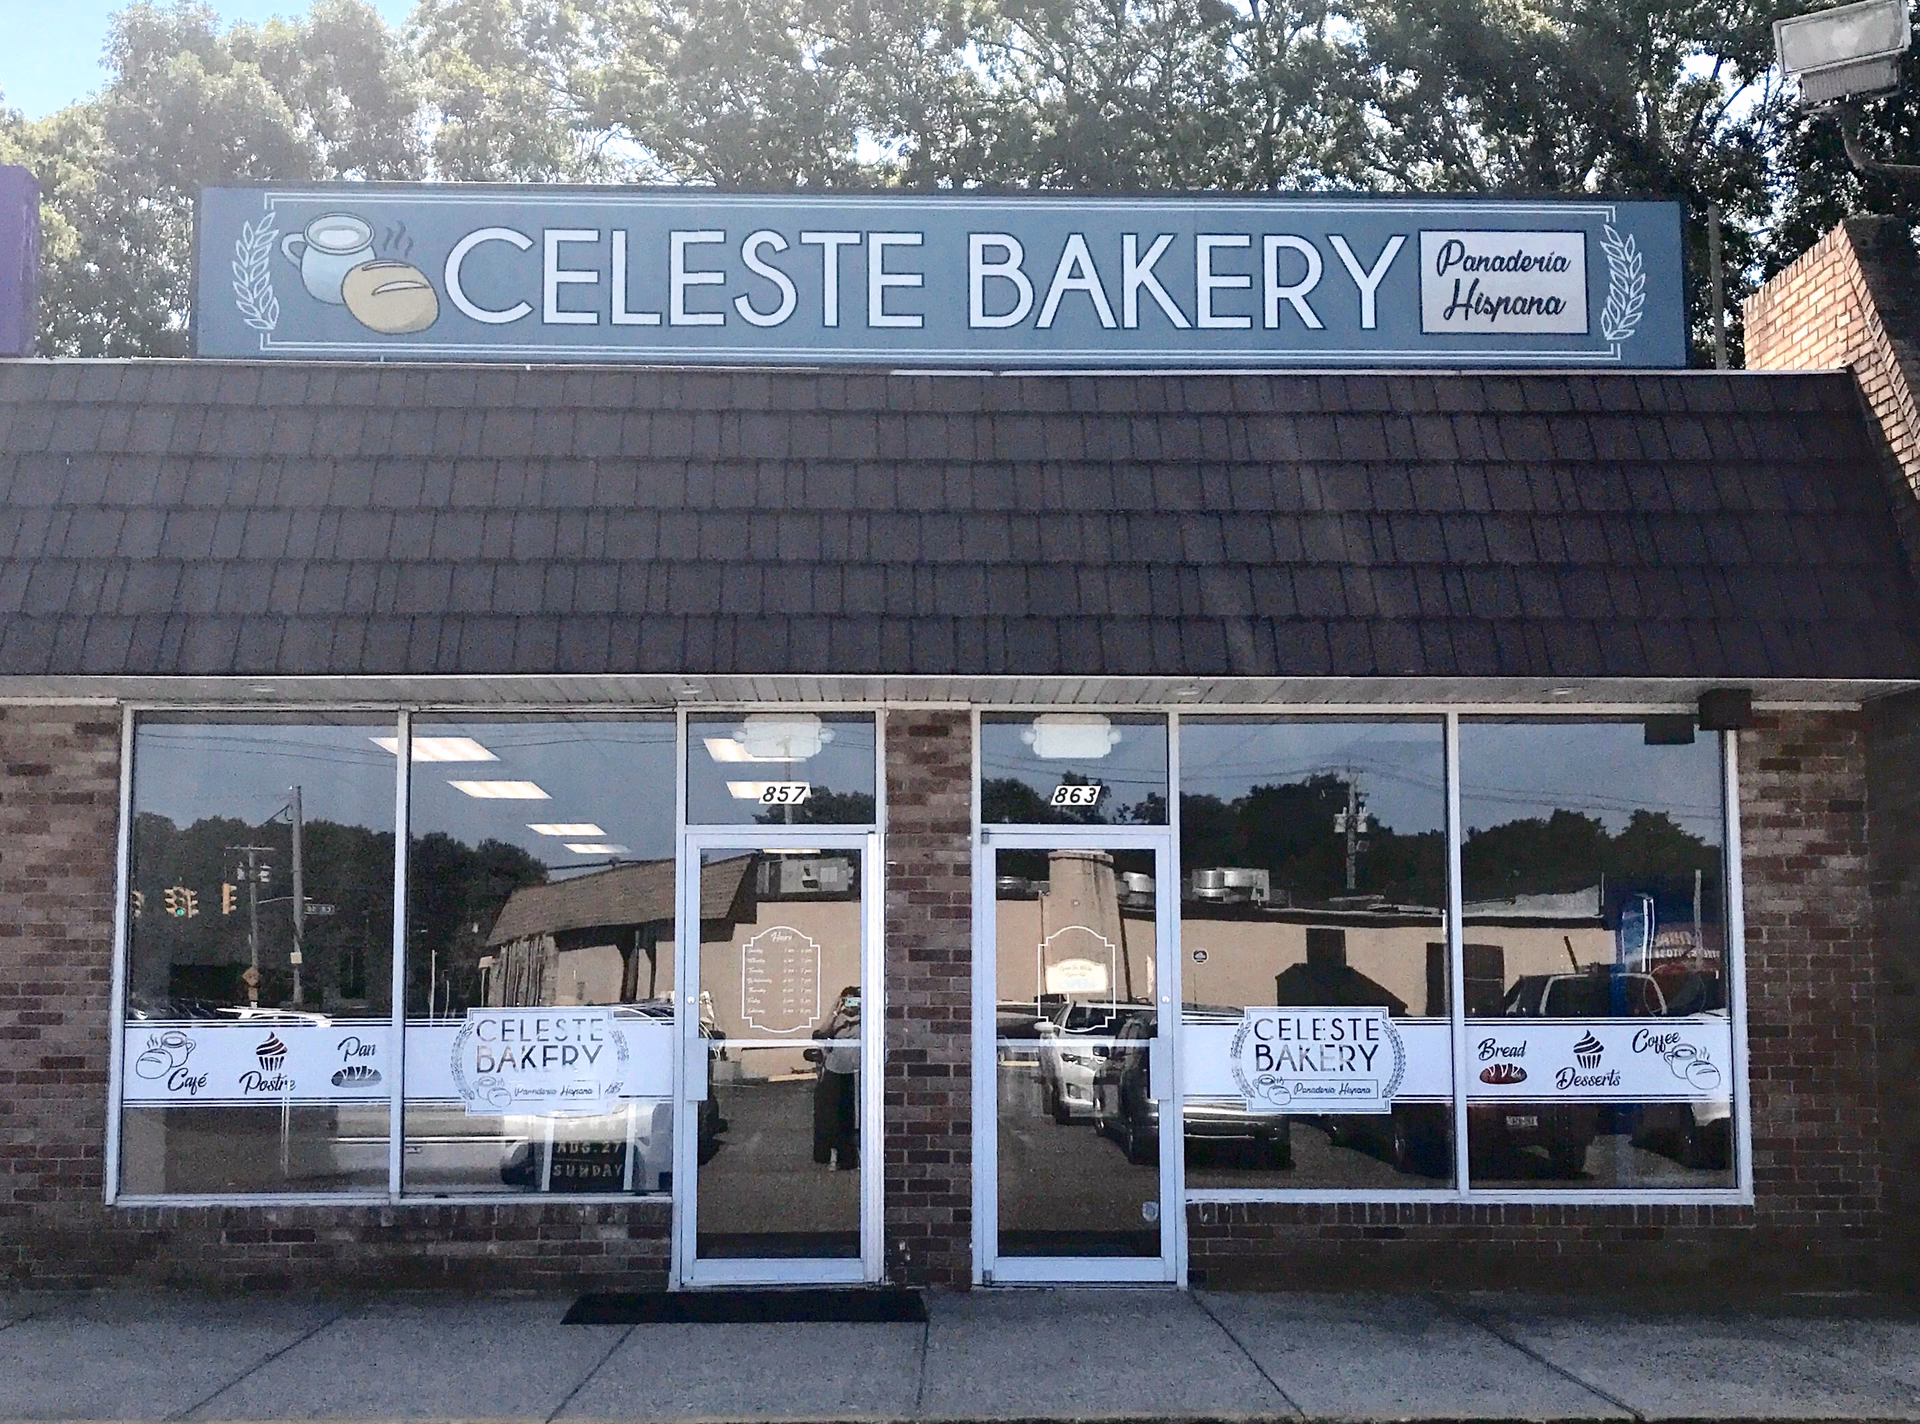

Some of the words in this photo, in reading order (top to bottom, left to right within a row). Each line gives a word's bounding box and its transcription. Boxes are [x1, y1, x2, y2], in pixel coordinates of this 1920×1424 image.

[1437, 239, 1571, 276] Panadería
[445, 227, 925, 329] CELESTE
[966, 232, 1408, 330] BAKERY
[1443, 278, 1567, 322] Hispana
[763, 786, 807, 803] 857
[1054, 787, 1098, 803] 863
[476, 1018, 604, 1042] CELESTE
[1254, 1018, 1379, 1041] CELESTE
[1632, 1028, 1681, 1054] Coffee
[337, 1036, 376, 1062] Pan
[476, 1044, 604, 1073] BAKERY
[1255, 1044, 1379, 1072] BAKERY
[1477, 1037, 1527, 1061] Bread
[167, 1067, 208, 1095] Café
[1555, 1067, 1621, 1090] Desserts
[553, 1163, 623, 1177] SUNDAY
